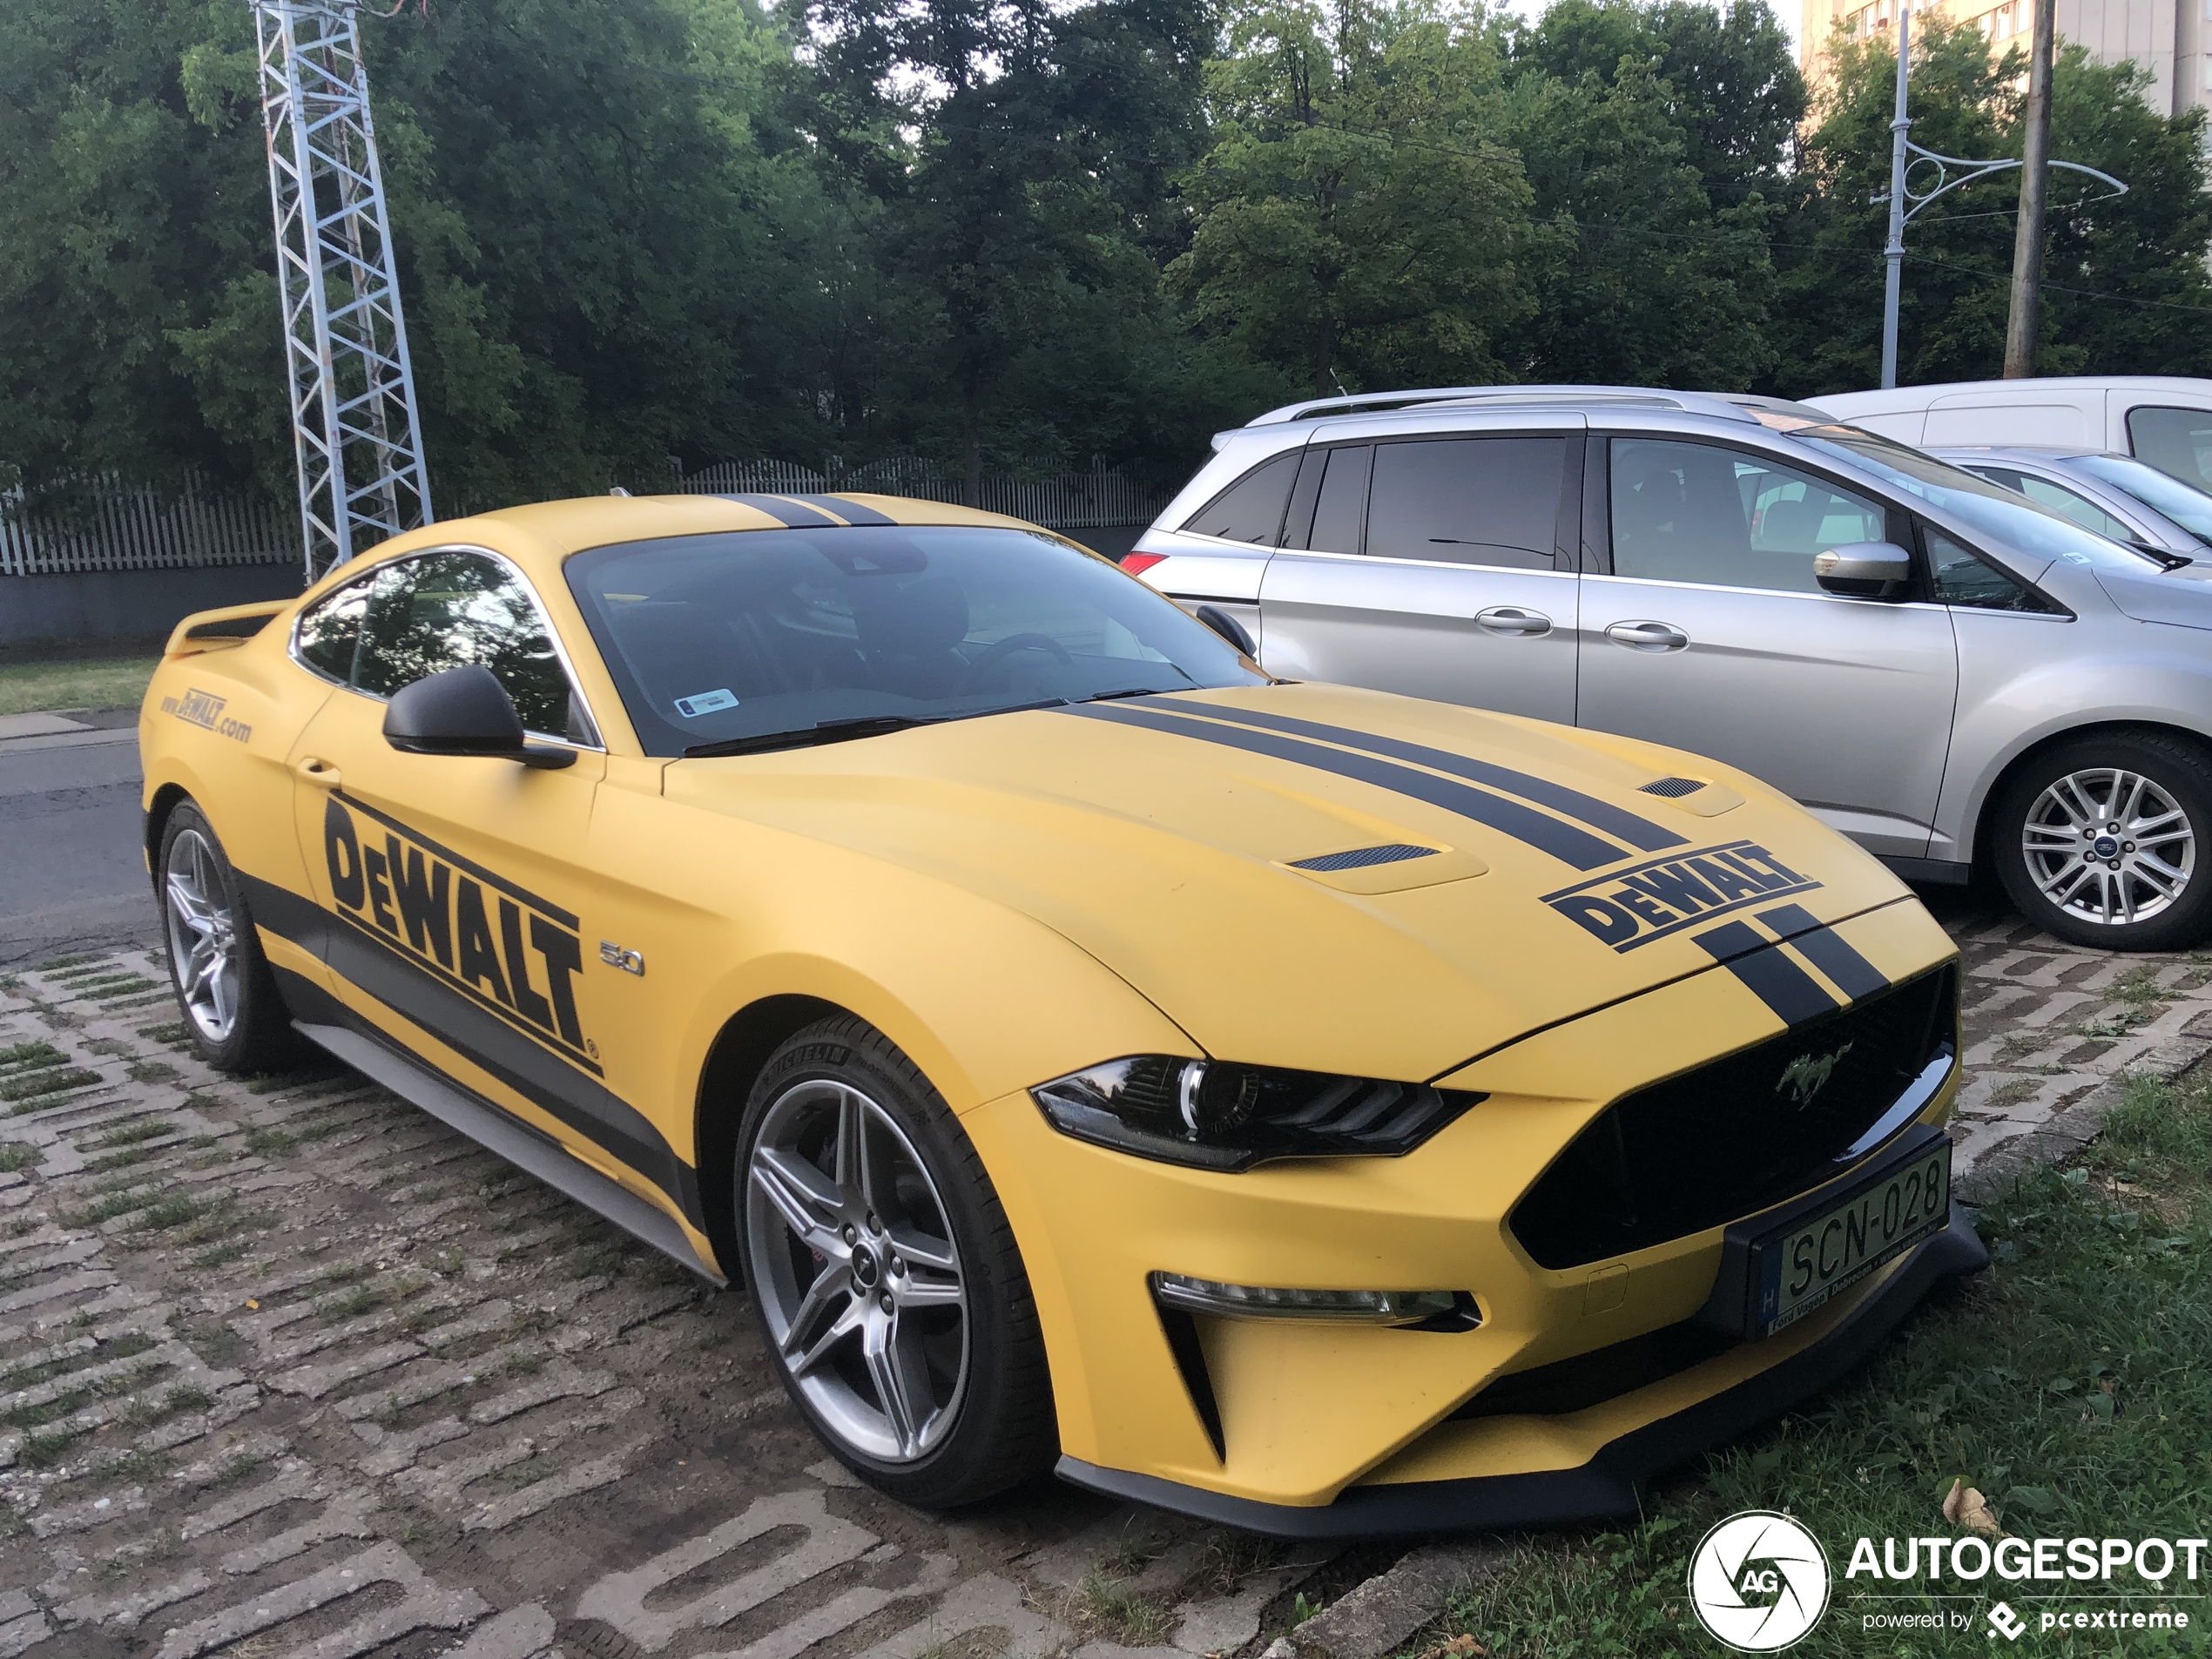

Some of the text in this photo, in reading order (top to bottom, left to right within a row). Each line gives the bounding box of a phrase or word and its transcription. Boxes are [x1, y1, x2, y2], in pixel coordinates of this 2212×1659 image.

[1790, 1159, 1940, 1297] SCN-028
[1763, 1287, 1774, 1313] H
[1772, 1310, 1794, 1332] Ford
